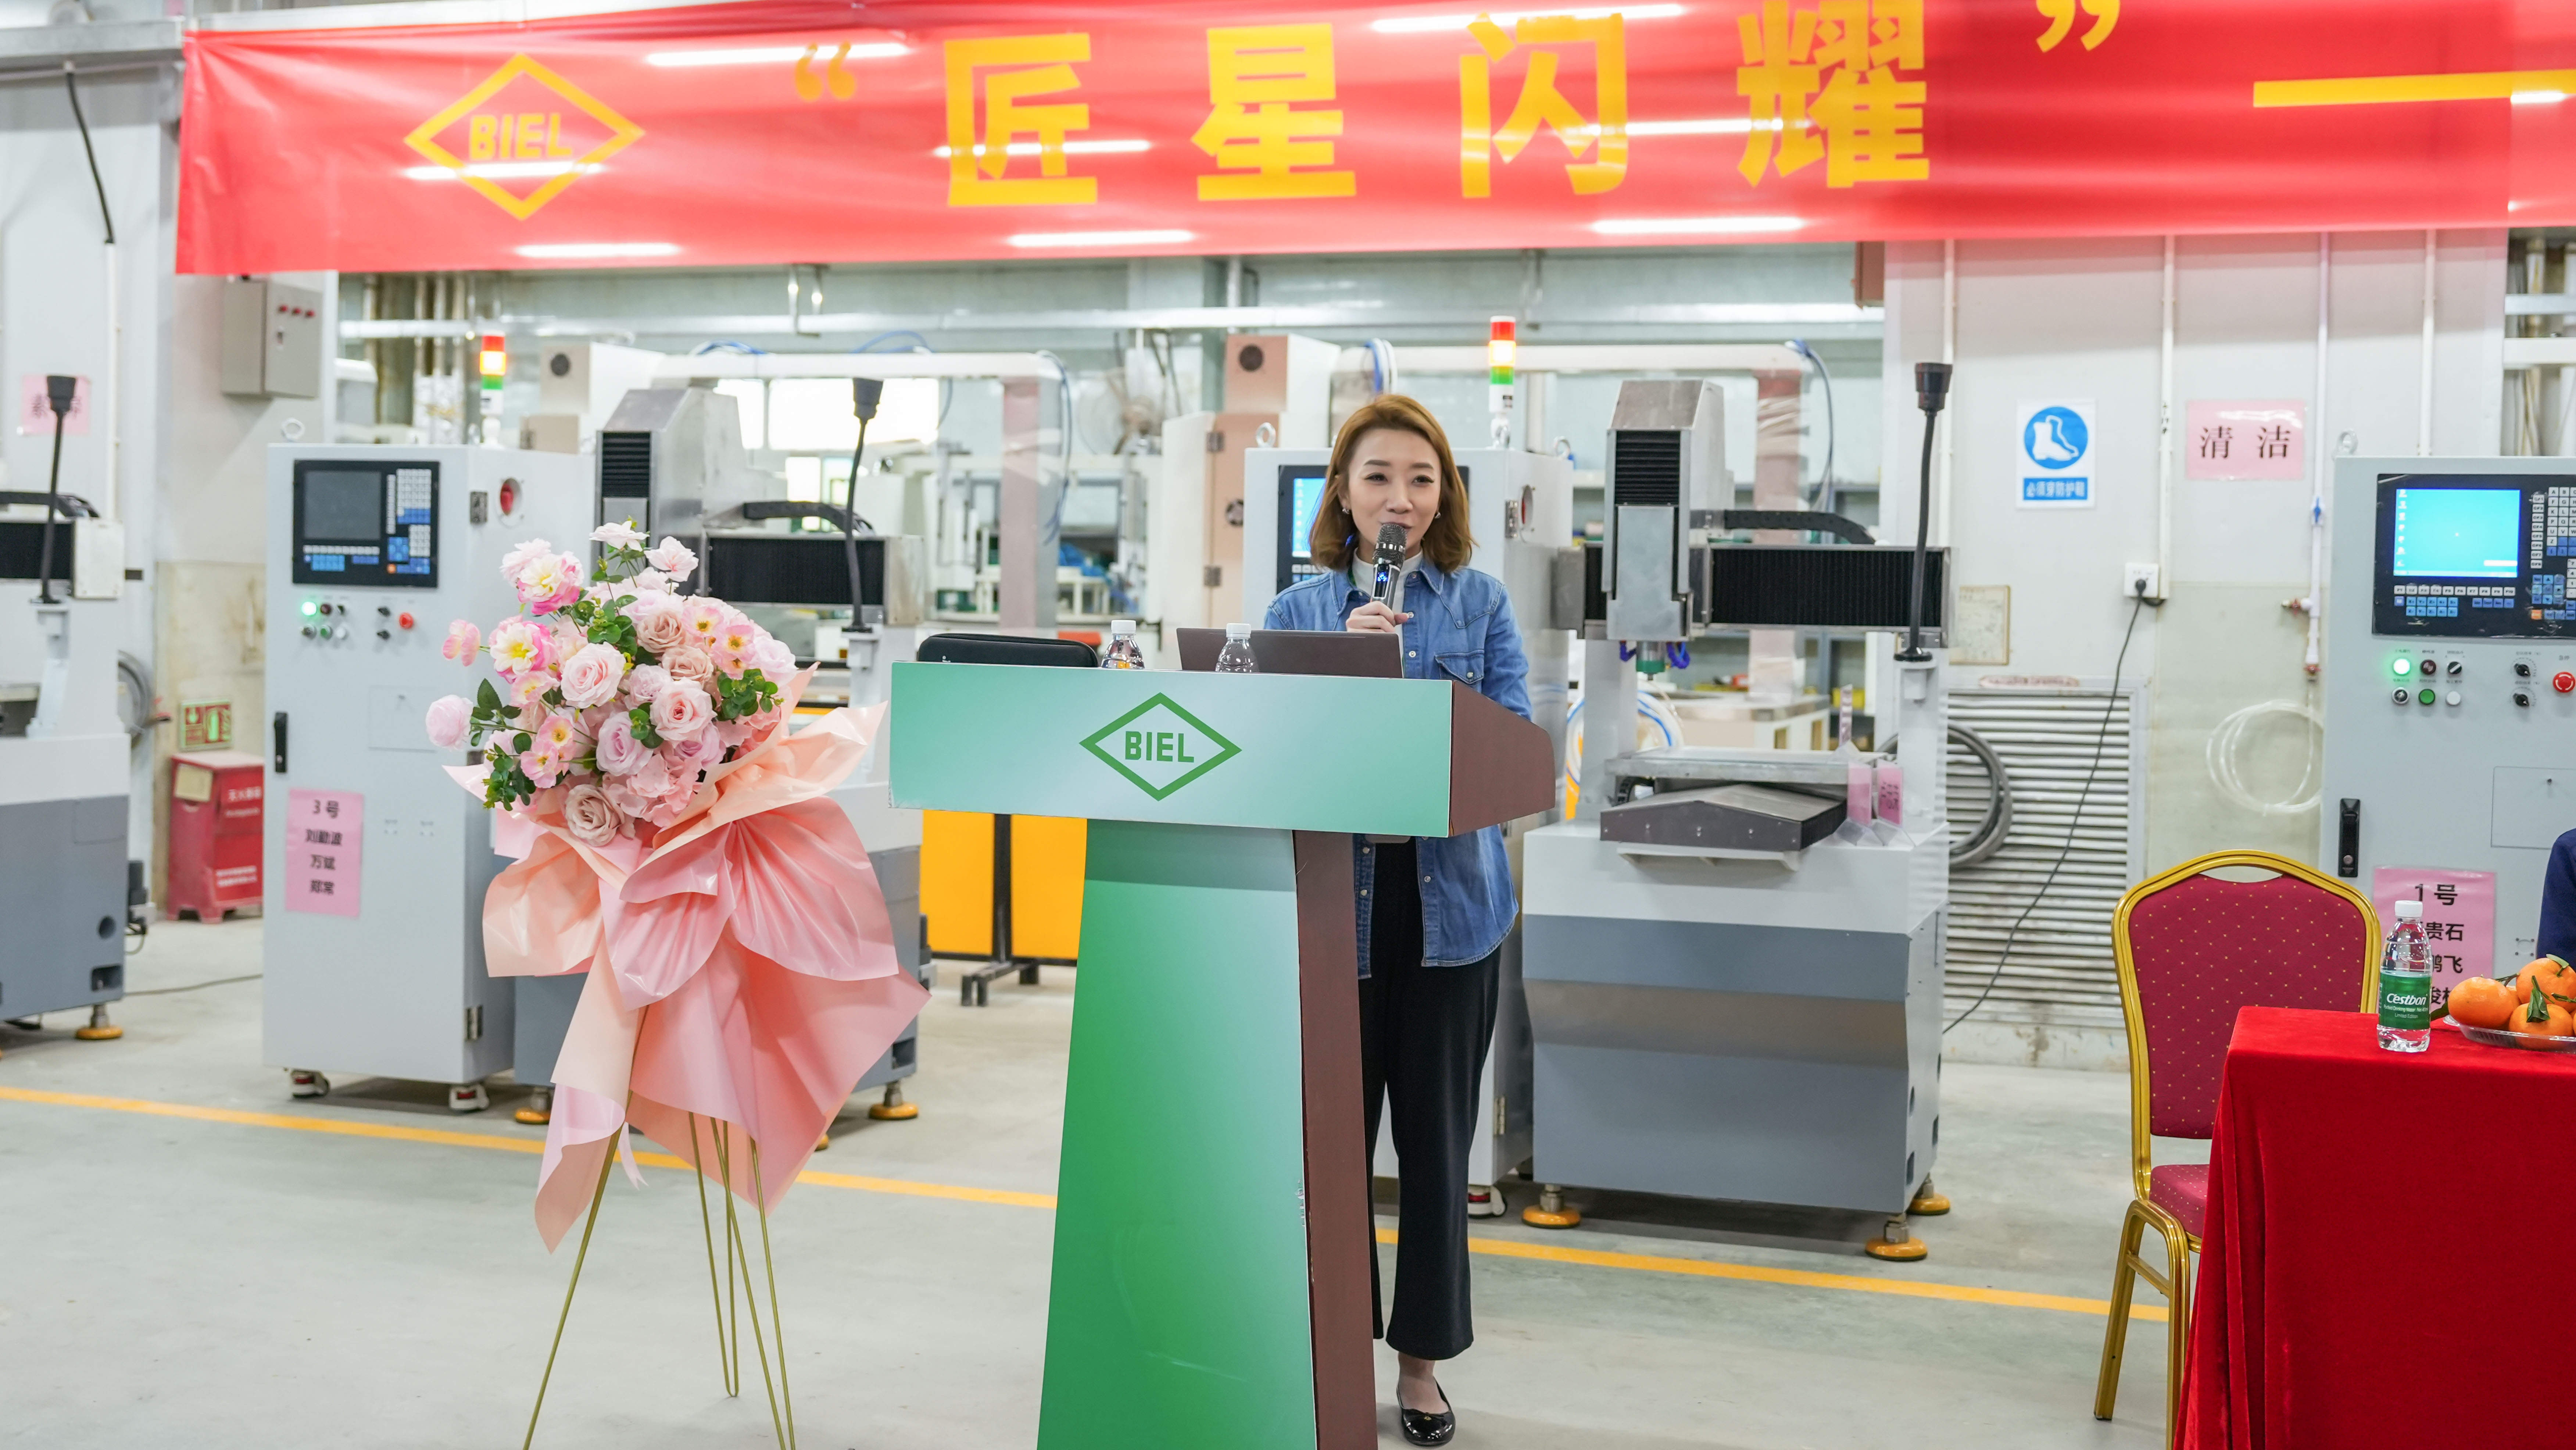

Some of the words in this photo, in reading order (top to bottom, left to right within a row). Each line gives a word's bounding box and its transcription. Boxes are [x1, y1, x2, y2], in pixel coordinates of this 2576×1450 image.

[469, 113, 572, 161] BIEL
[2200, 425, 2291, 458] 清洁
[1125, 731, 1194, 763] BIEL
[2422, 921, 2464, 941] 贵石
